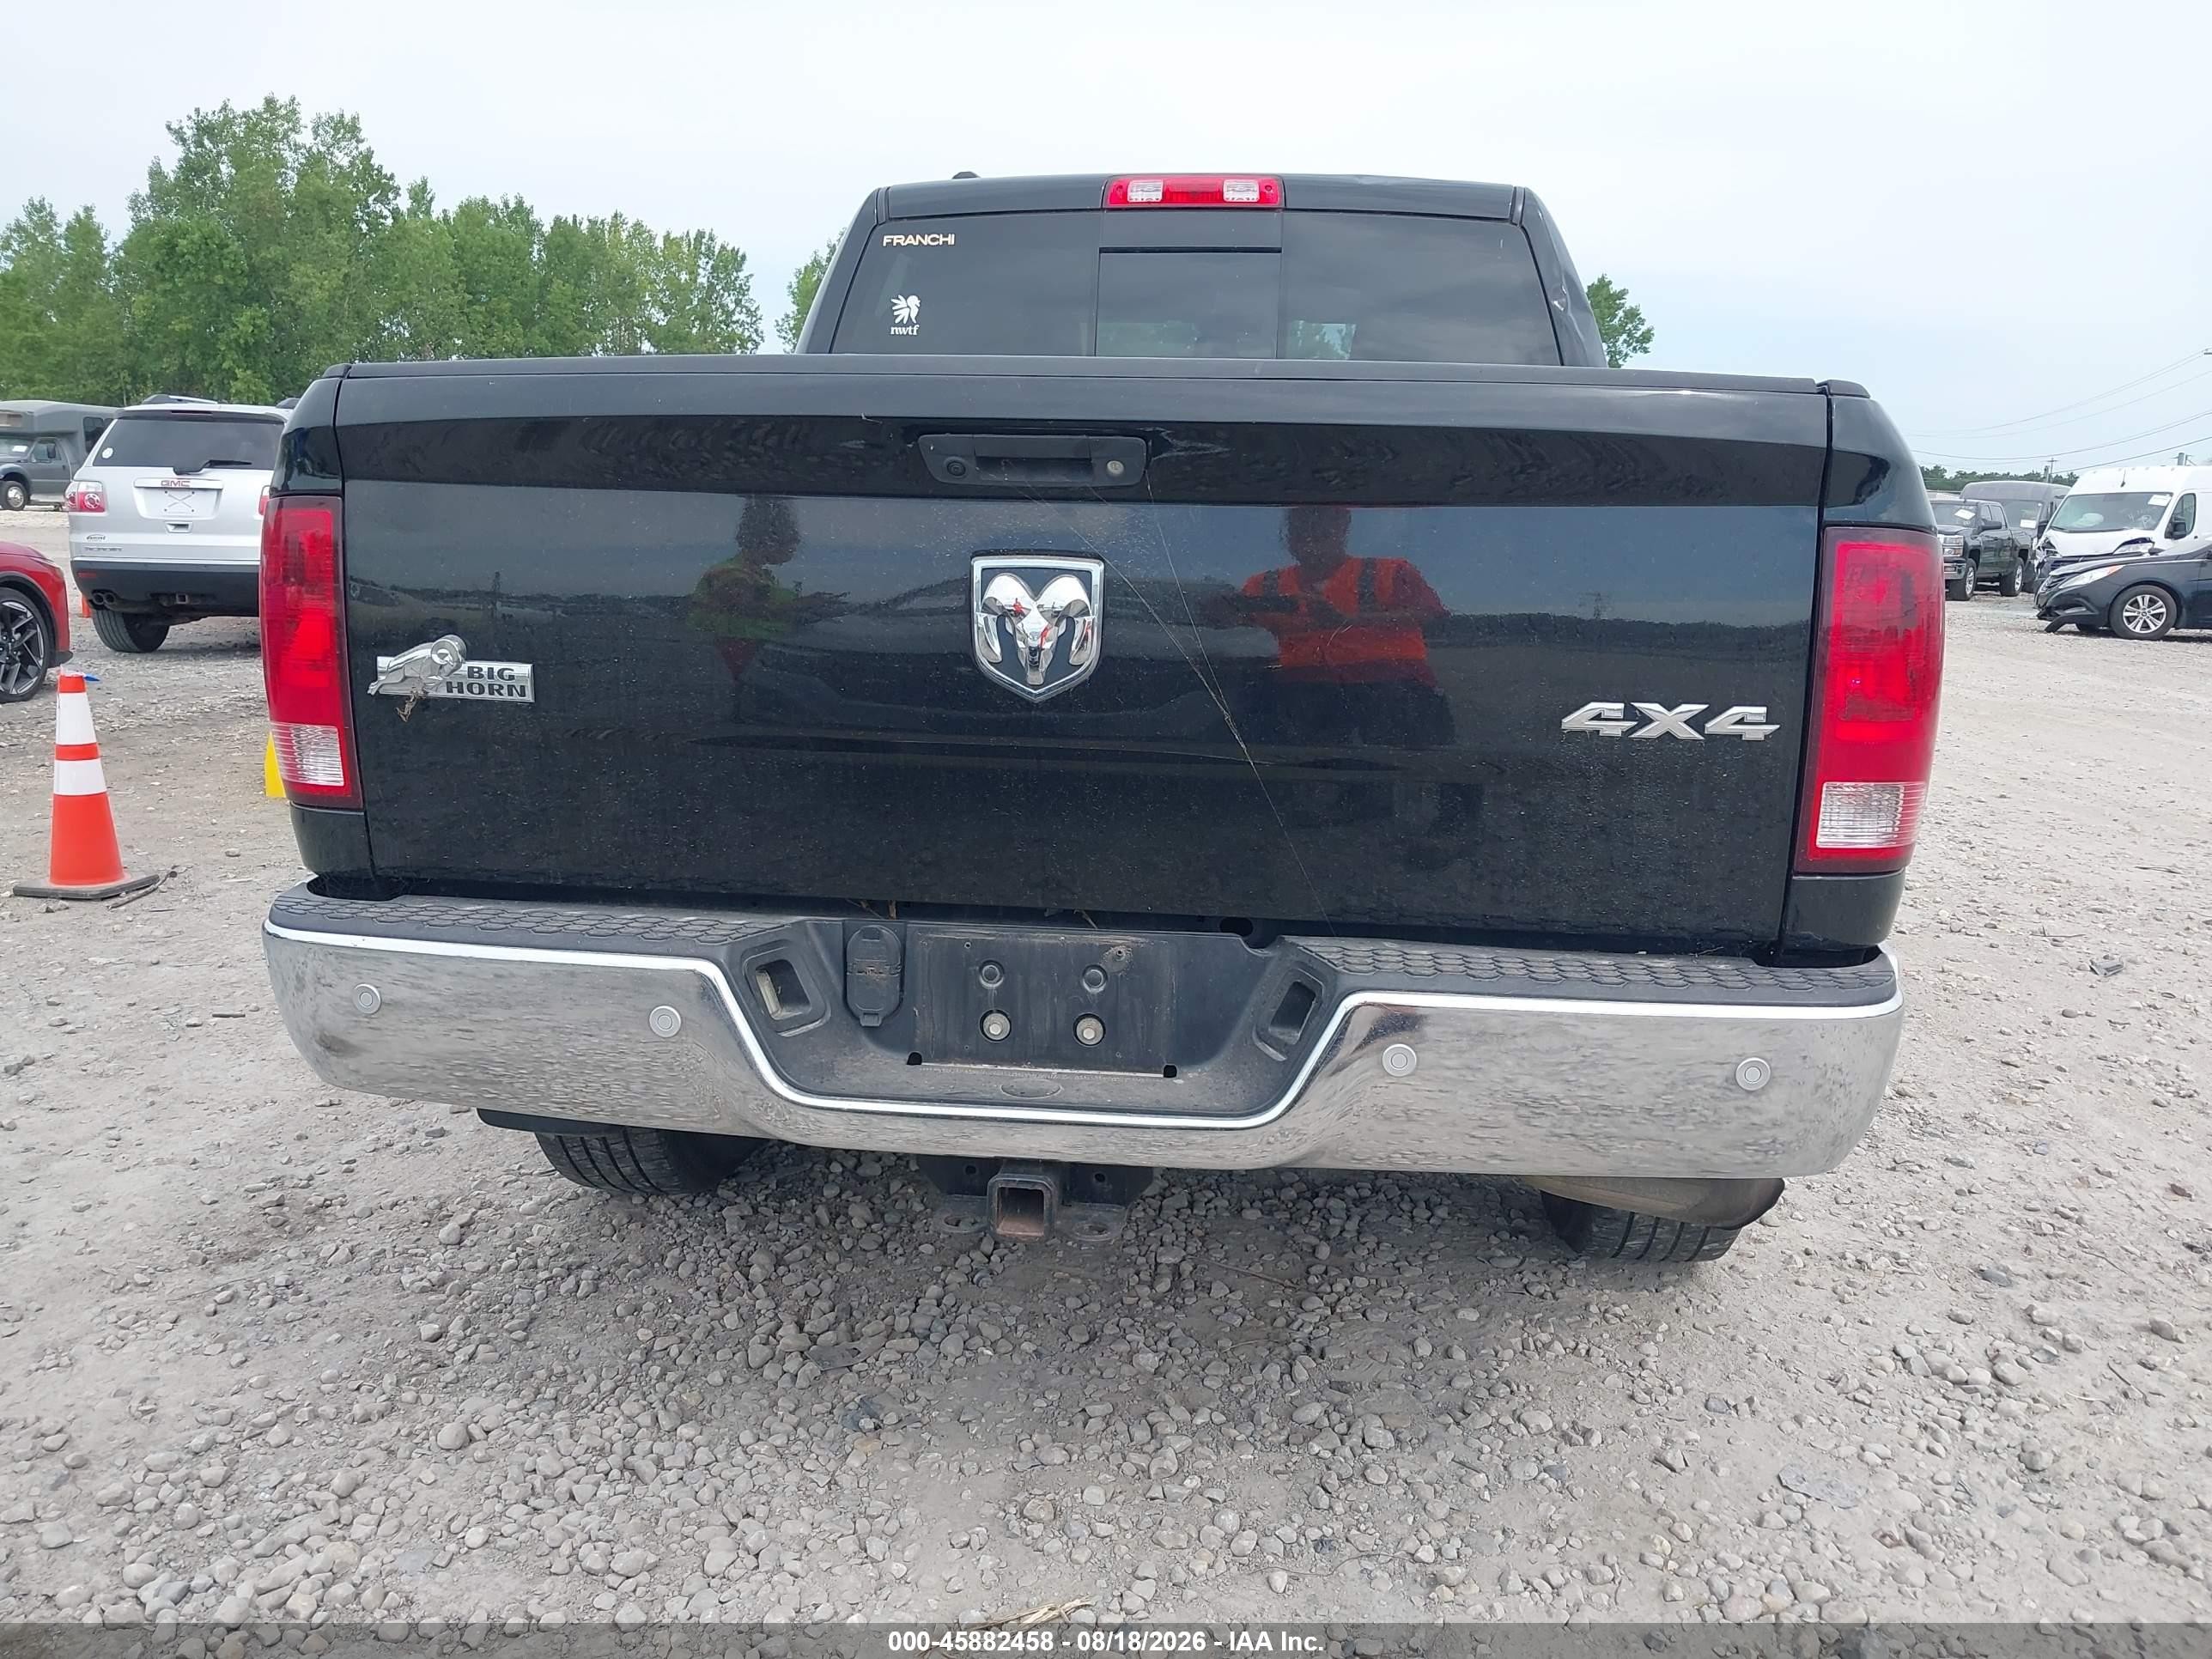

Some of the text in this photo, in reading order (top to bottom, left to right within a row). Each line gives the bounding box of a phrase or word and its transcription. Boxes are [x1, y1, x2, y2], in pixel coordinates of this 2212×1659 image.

[882, 234, 955, 246] FRANCHI
[890, 325, 920, 336] nwtf
[467, 665, 516, 682] BIG
[446, 681, 526, 697] HORN
[1561, 702, 1781, 741] 4X4
